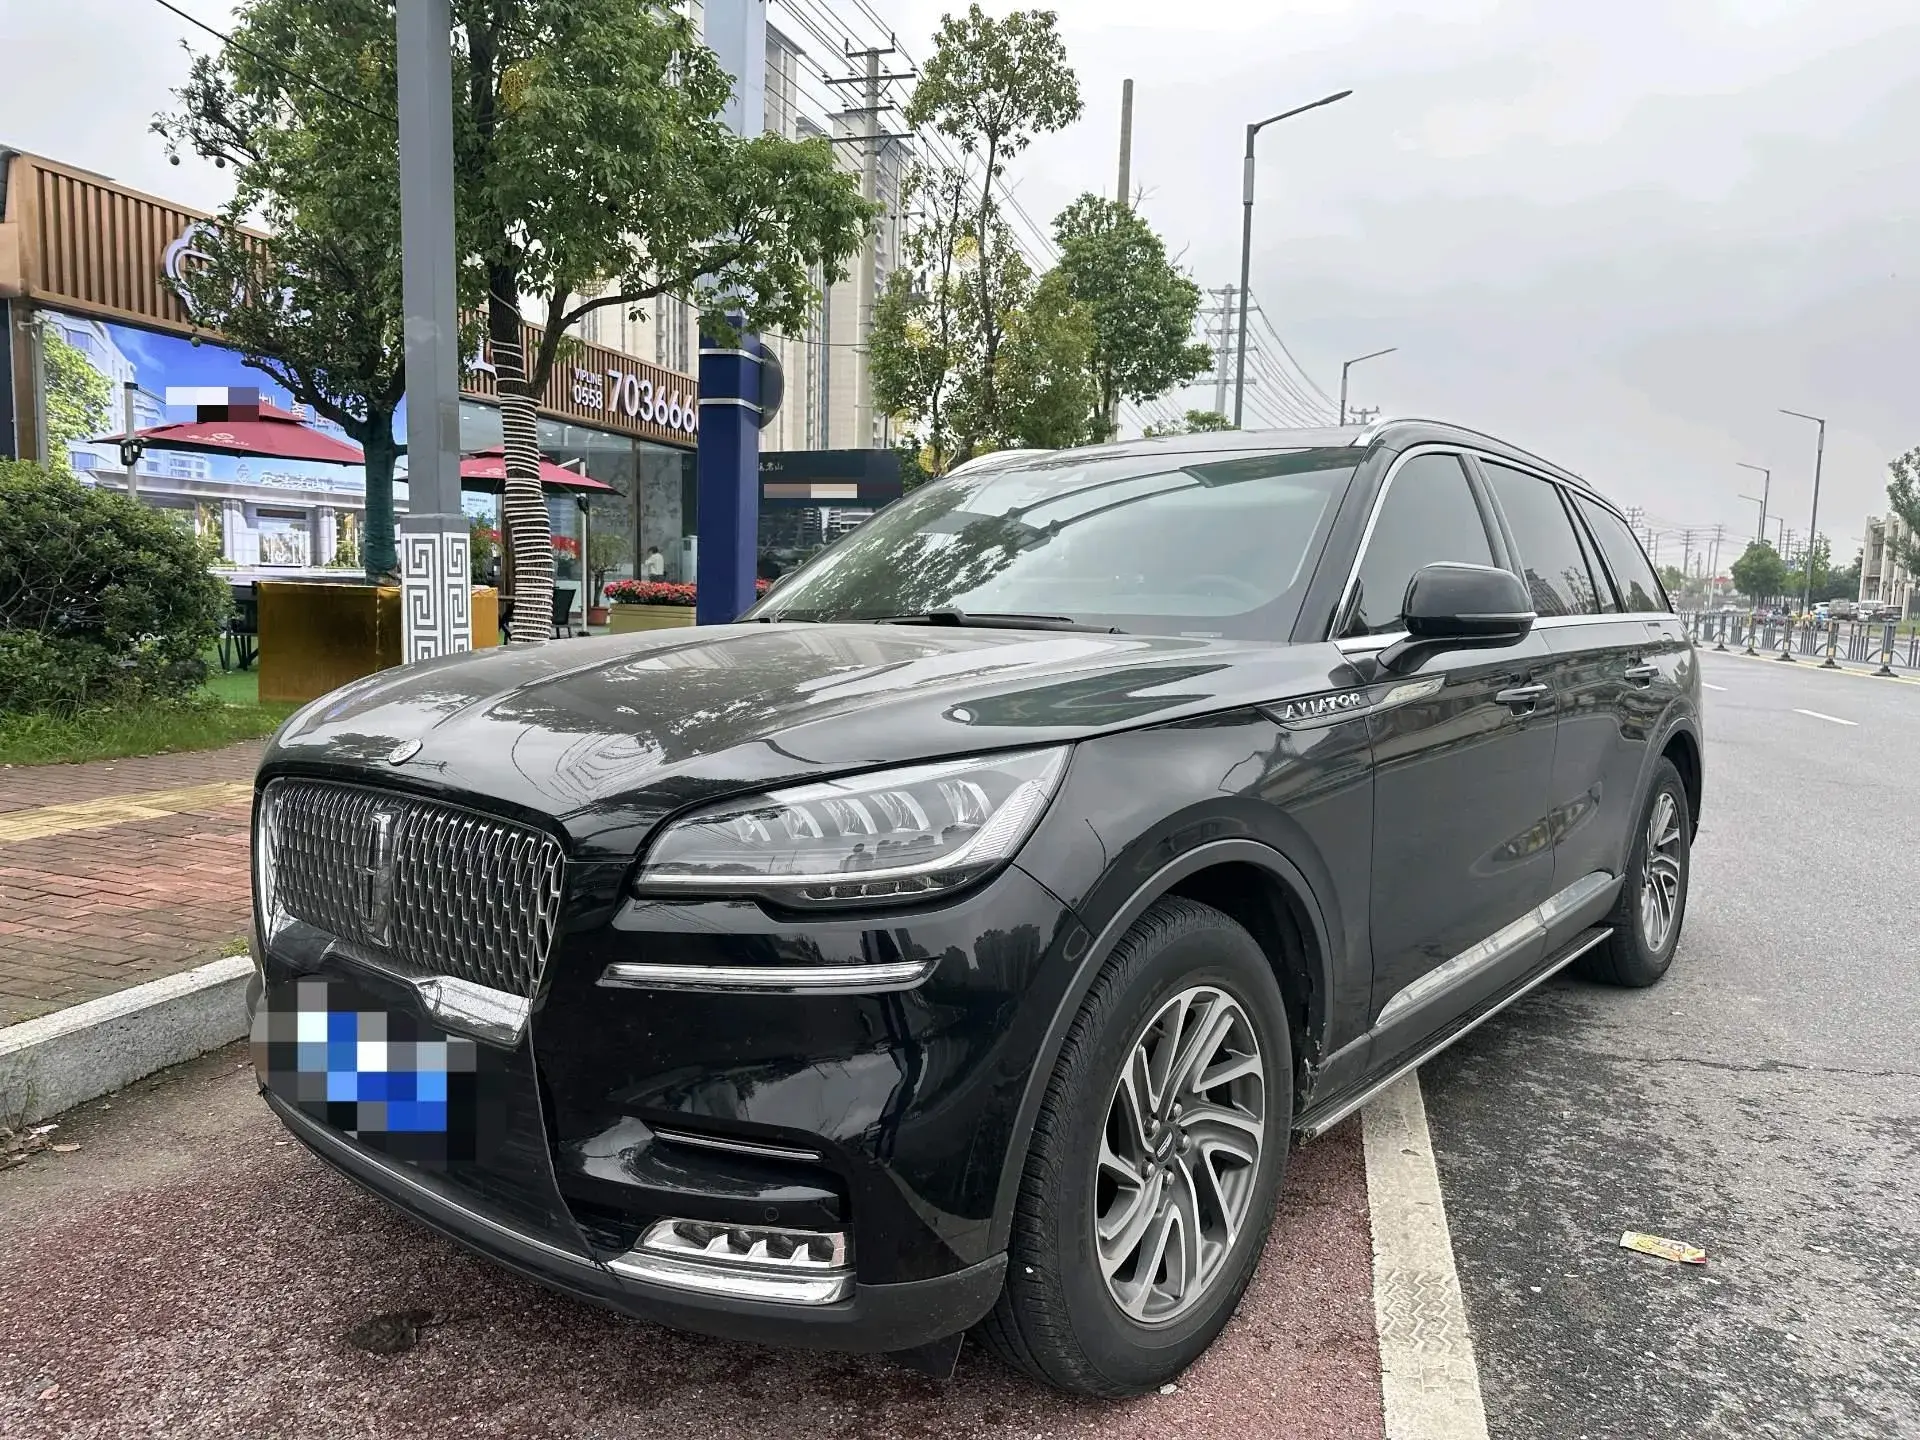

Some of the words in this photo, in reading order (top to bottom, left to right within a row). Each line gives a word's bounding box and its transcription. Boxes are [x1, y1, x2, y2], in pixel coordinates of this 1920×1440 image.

[574, 384, 603, 410] 0558
[607, 368, 699, 433] 703666
[1285, 692, 1361, 719] AVIATOR
